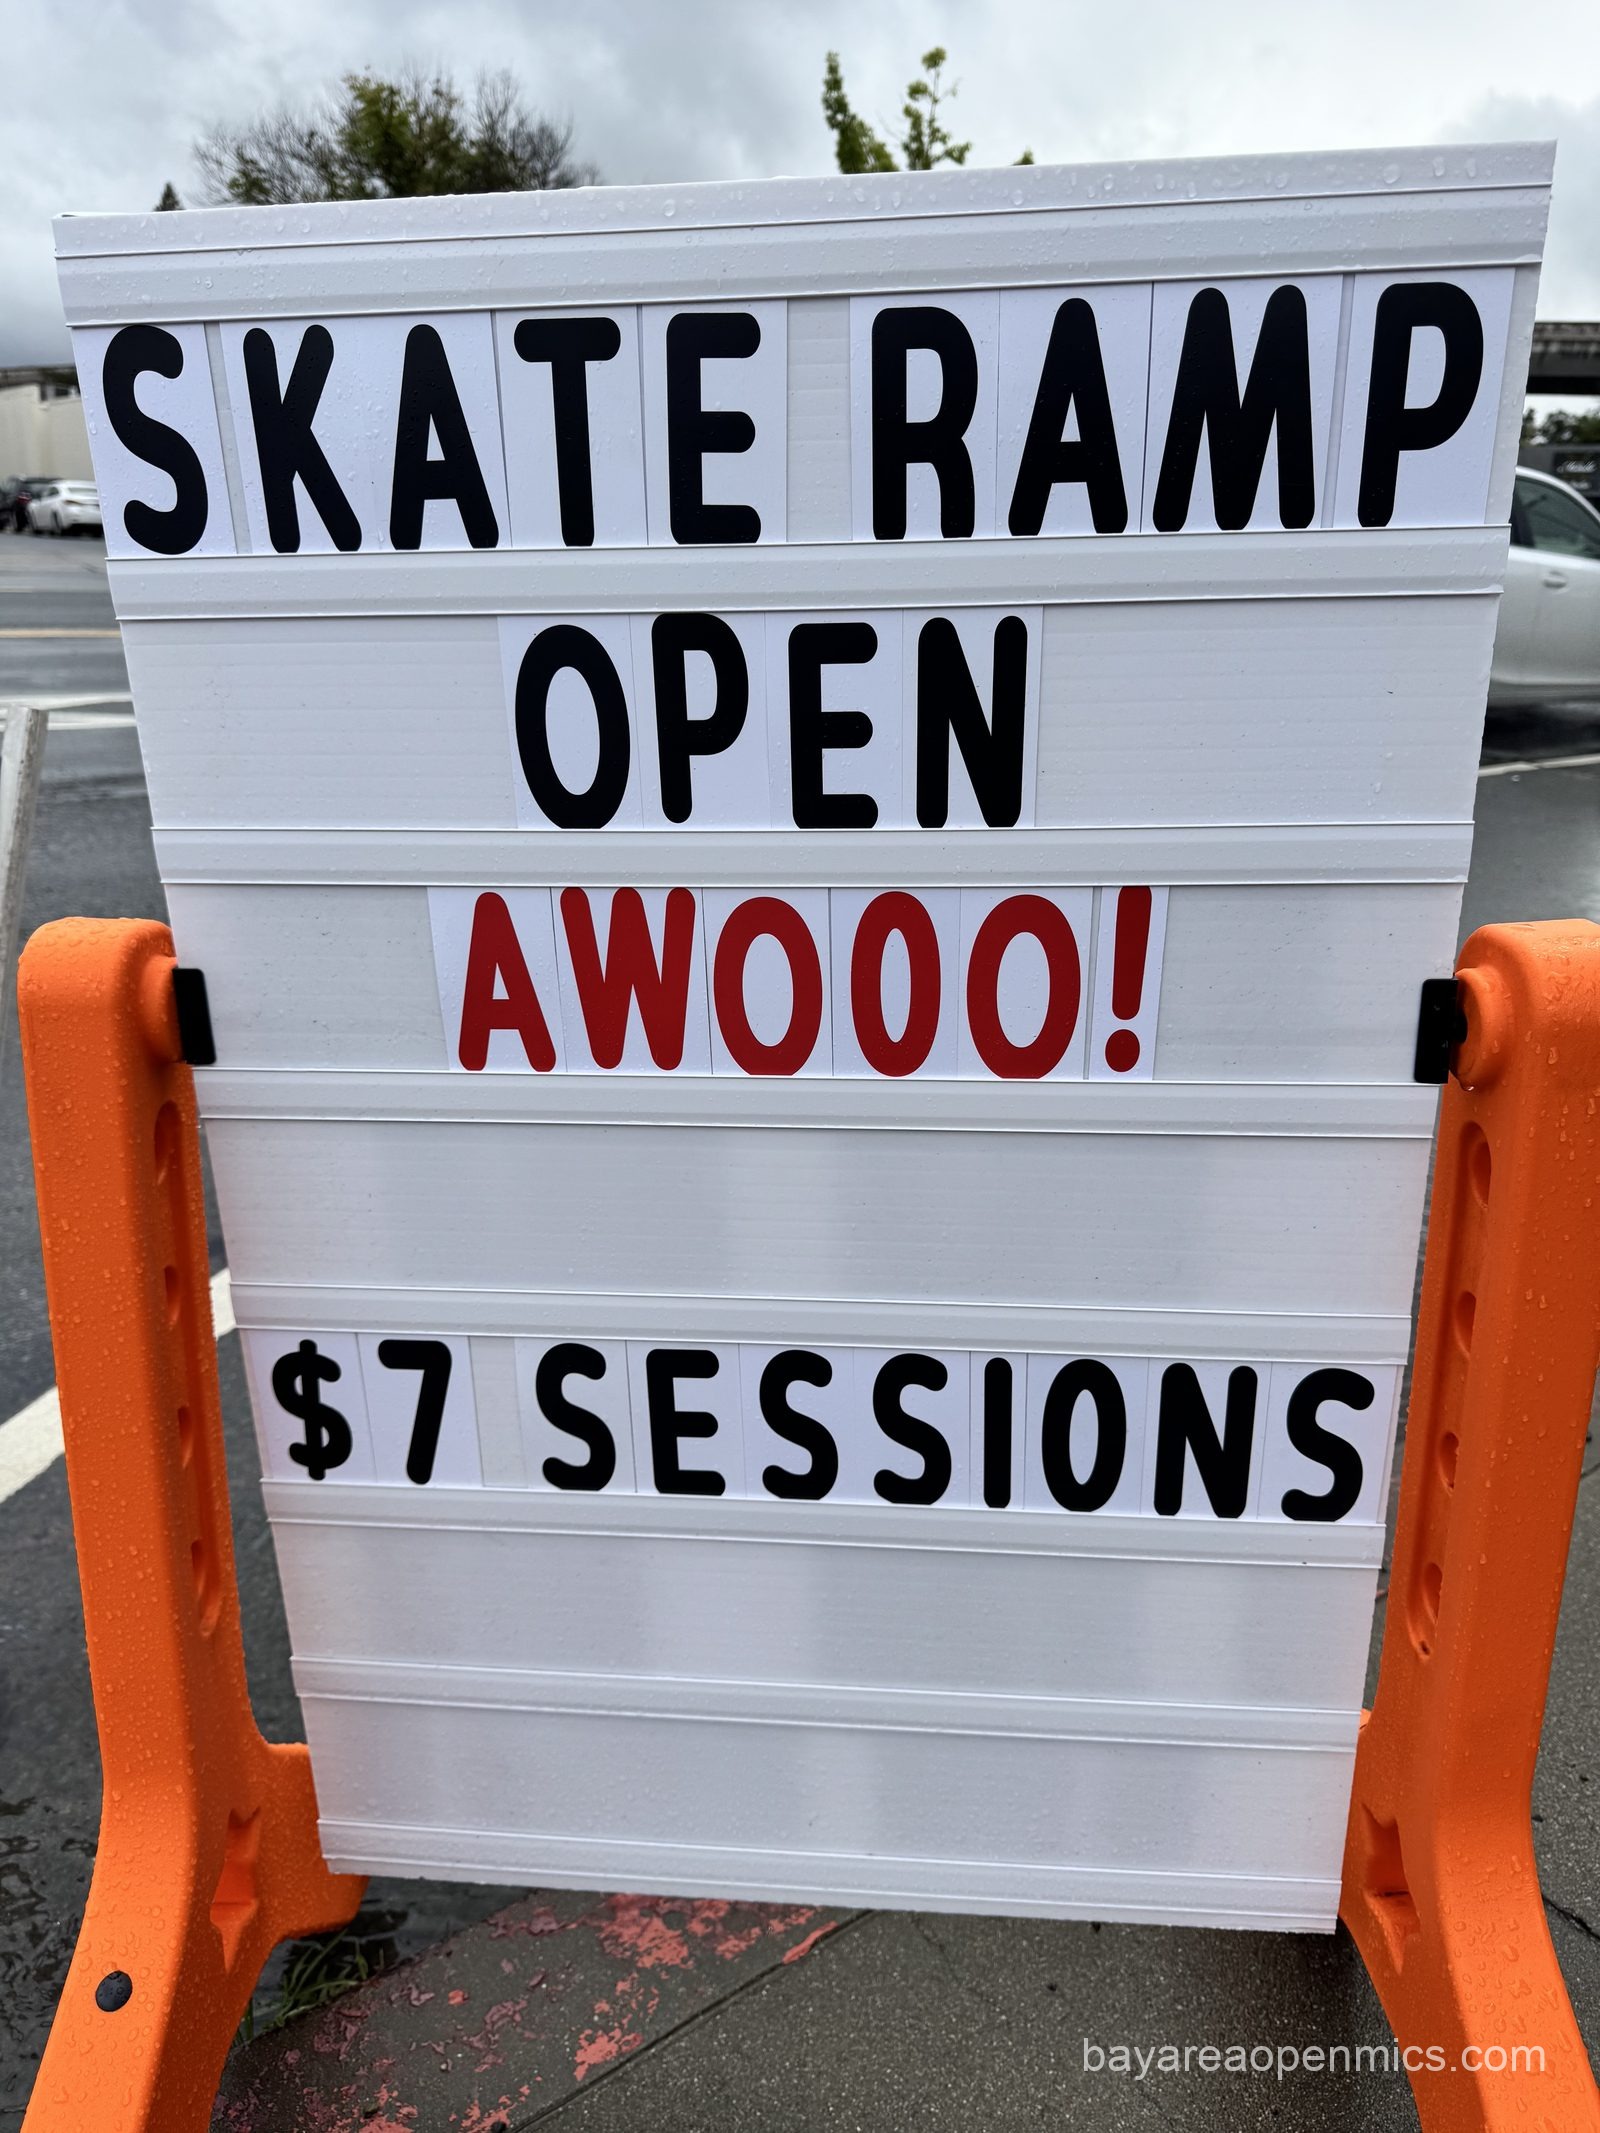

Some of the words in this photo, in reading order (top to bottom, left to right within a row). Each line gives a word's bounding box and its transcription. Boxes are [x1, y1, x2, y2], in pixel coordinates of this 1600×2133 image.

[103, 313, 762, 555] SKATE
[872, 282, 1483, 540] RAMP
[515, 612, 1027, 830] OPEN
[459, 886, 1152, 1079] AWOOO!
[272, 1339, 452, 1485] $7
[536, 1343, 1374, 1523] SESSIONS
